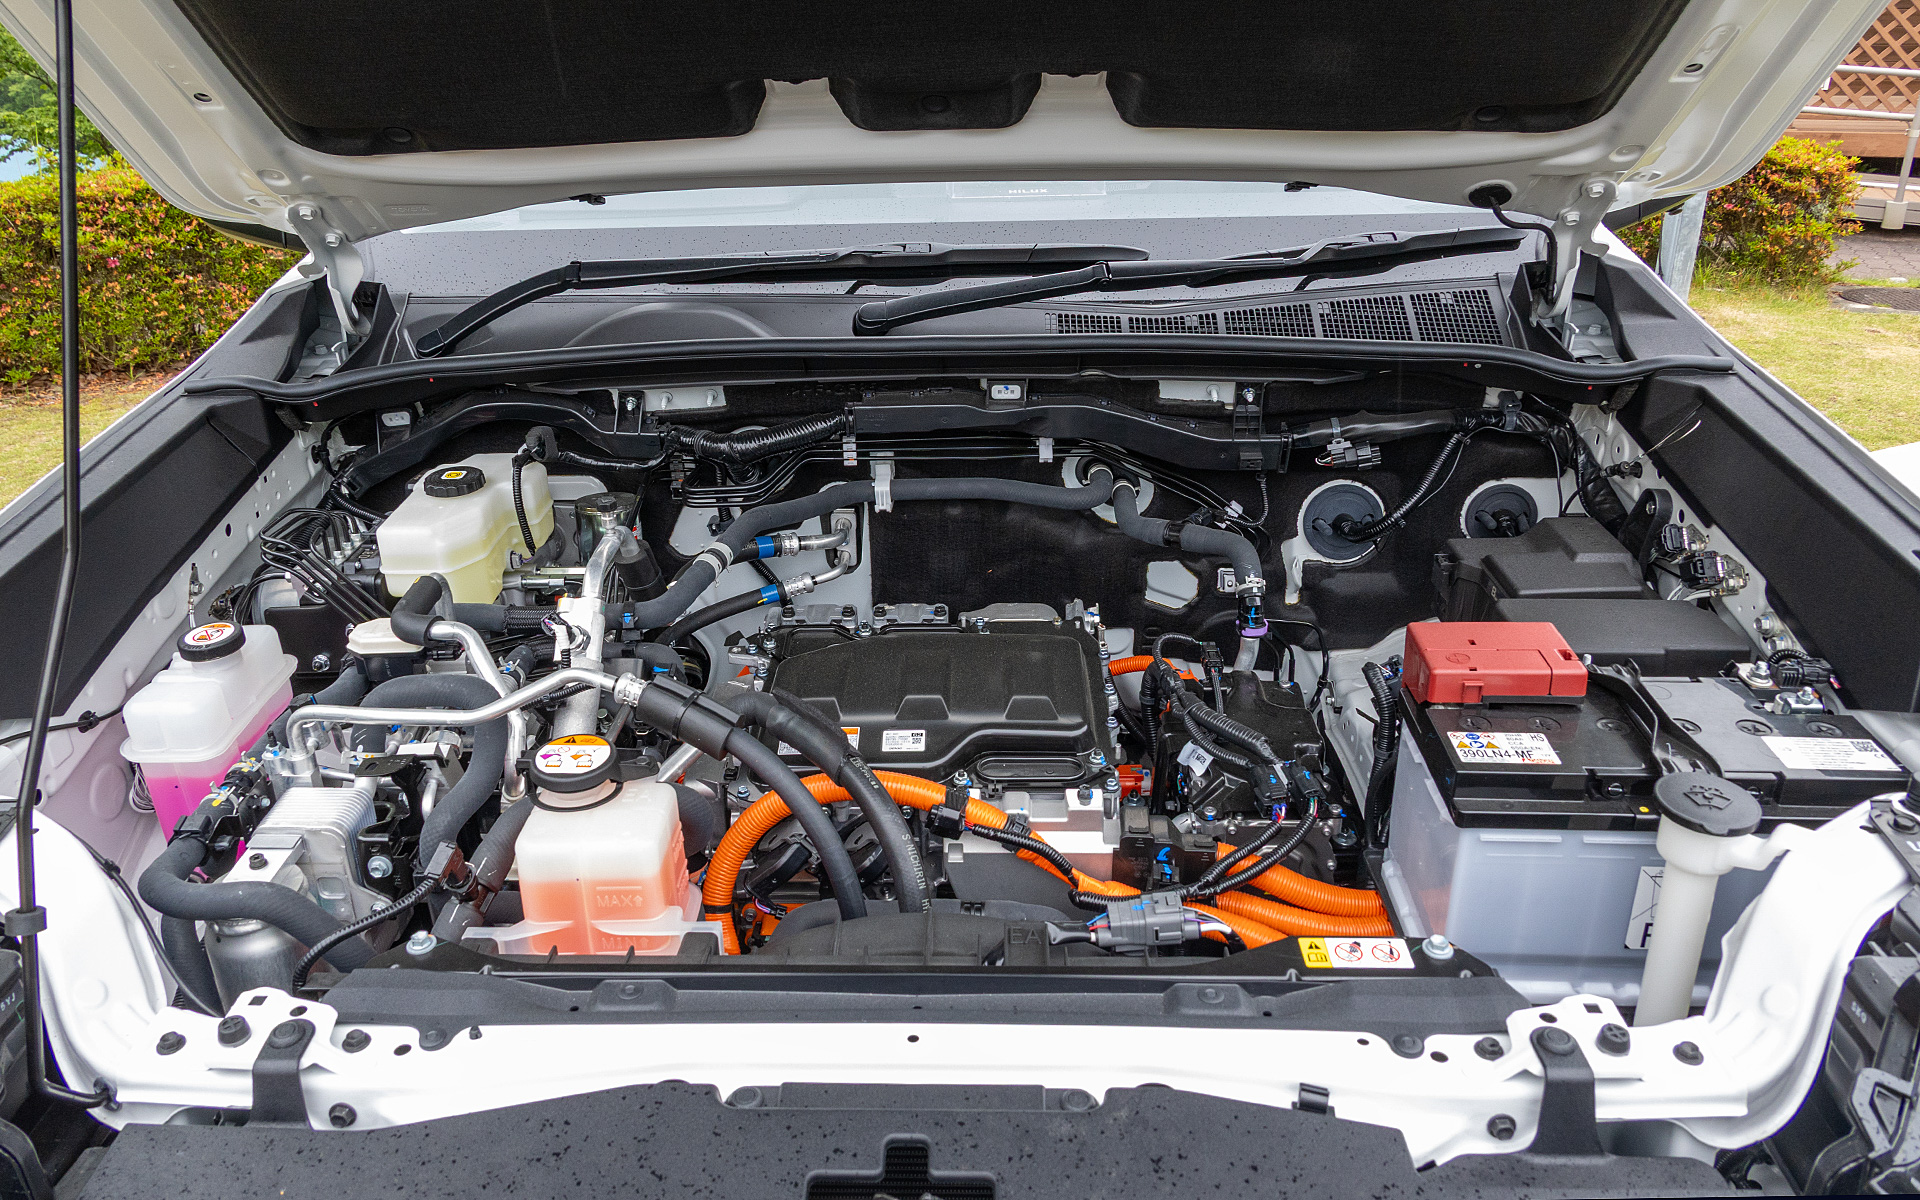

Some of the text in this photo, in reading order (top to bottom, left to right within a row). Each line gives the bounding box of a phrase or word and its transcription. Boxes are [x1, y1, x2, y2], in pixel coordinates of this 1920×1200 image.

[1529, 734, 1545, 742] HS
[1459, 749, 1535, 759] 390LN4-MF
[906, 843, 927, 890] NICHIRIN
[596, 894, 633, 907] MAX
[1010, 926, 1042, 945] EA
[601, 937, 637, 949] MIN
